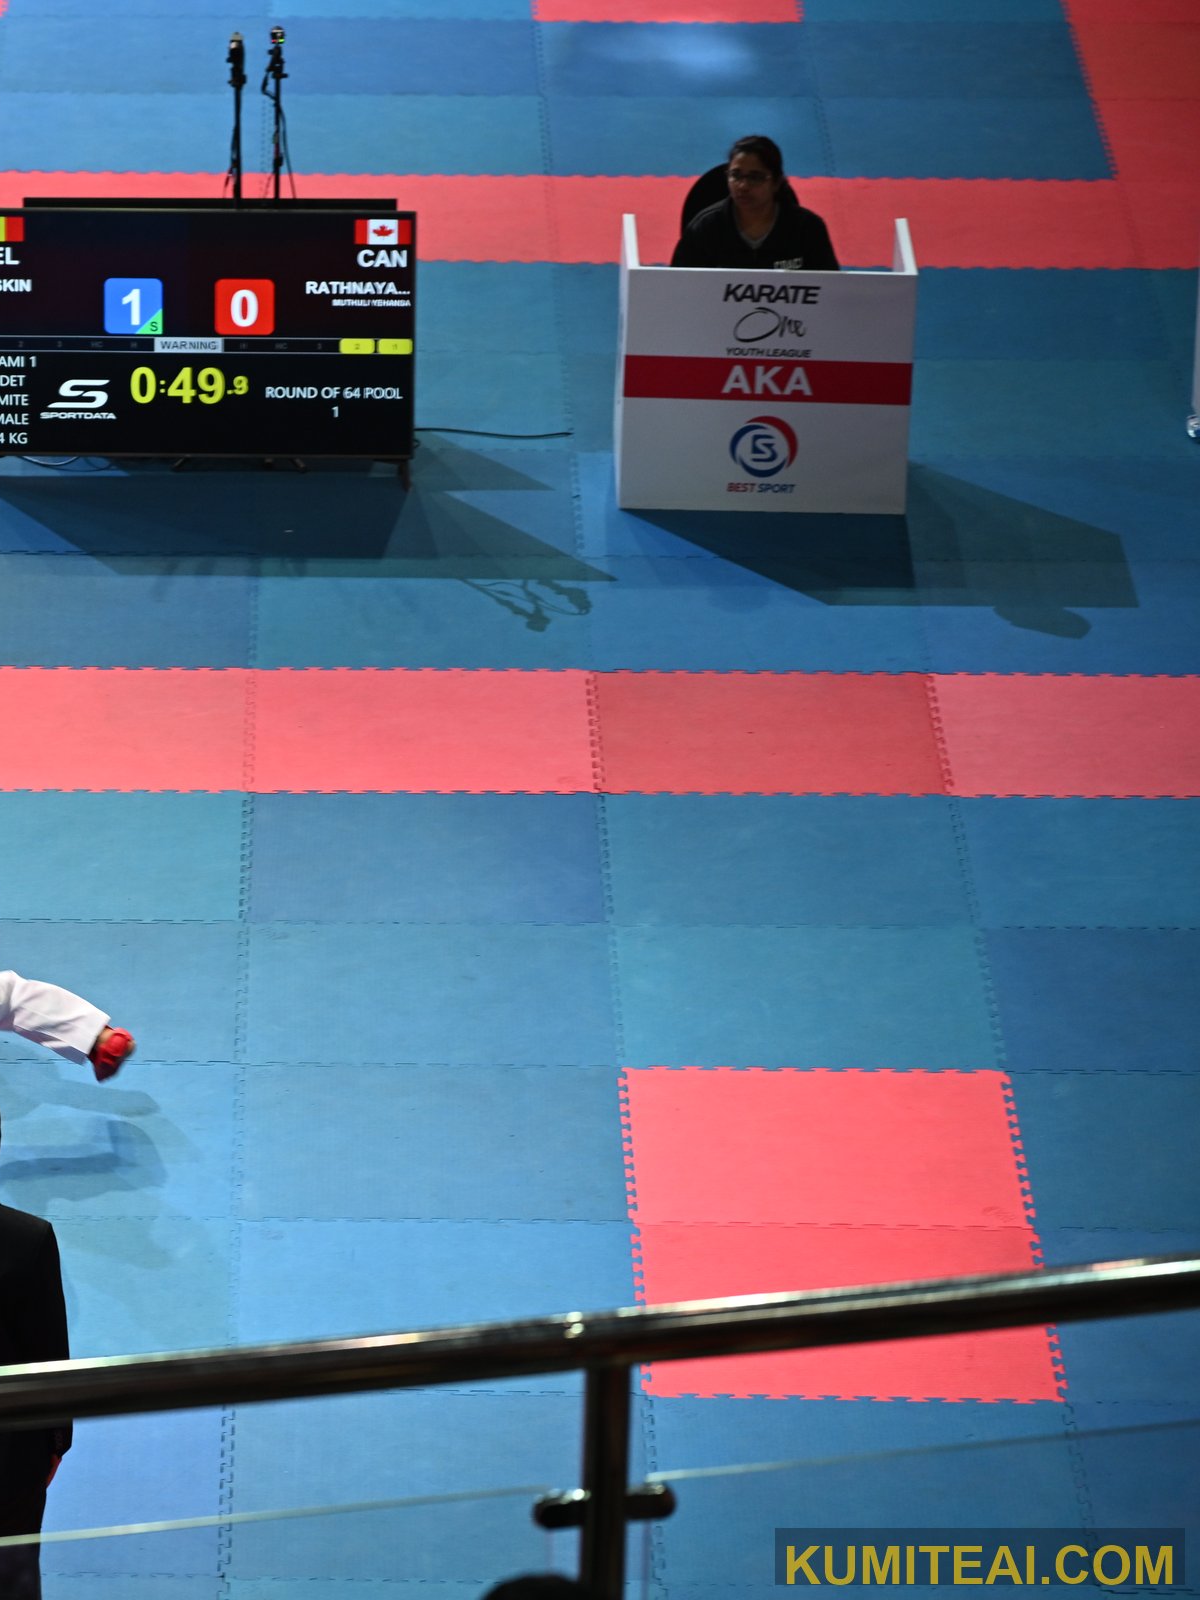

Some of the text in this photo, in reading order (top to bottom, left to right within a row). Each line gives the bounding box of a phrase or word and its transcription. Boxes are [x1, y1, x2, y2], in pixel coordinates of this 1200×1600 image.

[357, 249, 408, 268] CAN
[305, 281, 411, 295] RATHNAYA...
[723, 283, 821, 304] KARATE
[121, 288, 141, 326] 1
[230, 289, 259, 327] 0
[149, 321, 158, 333] S
[733, 307, 806, 343] One
[160, 340, 217, 351] WARNING
[726, 348, 811, 358] YOUTH LEAGUE
[29, 356, 37, 368] 1
[721, 365, 813, 396] AKA
[265, 386, 403, 399] ROUND OF 64 POOL
[40, 412, 117, 420] SPORTDATA
[331, 406, 340, 418] 1
[9, 432, 28, 445] KG
[727, 482, 795, 494] BEST SPORT
